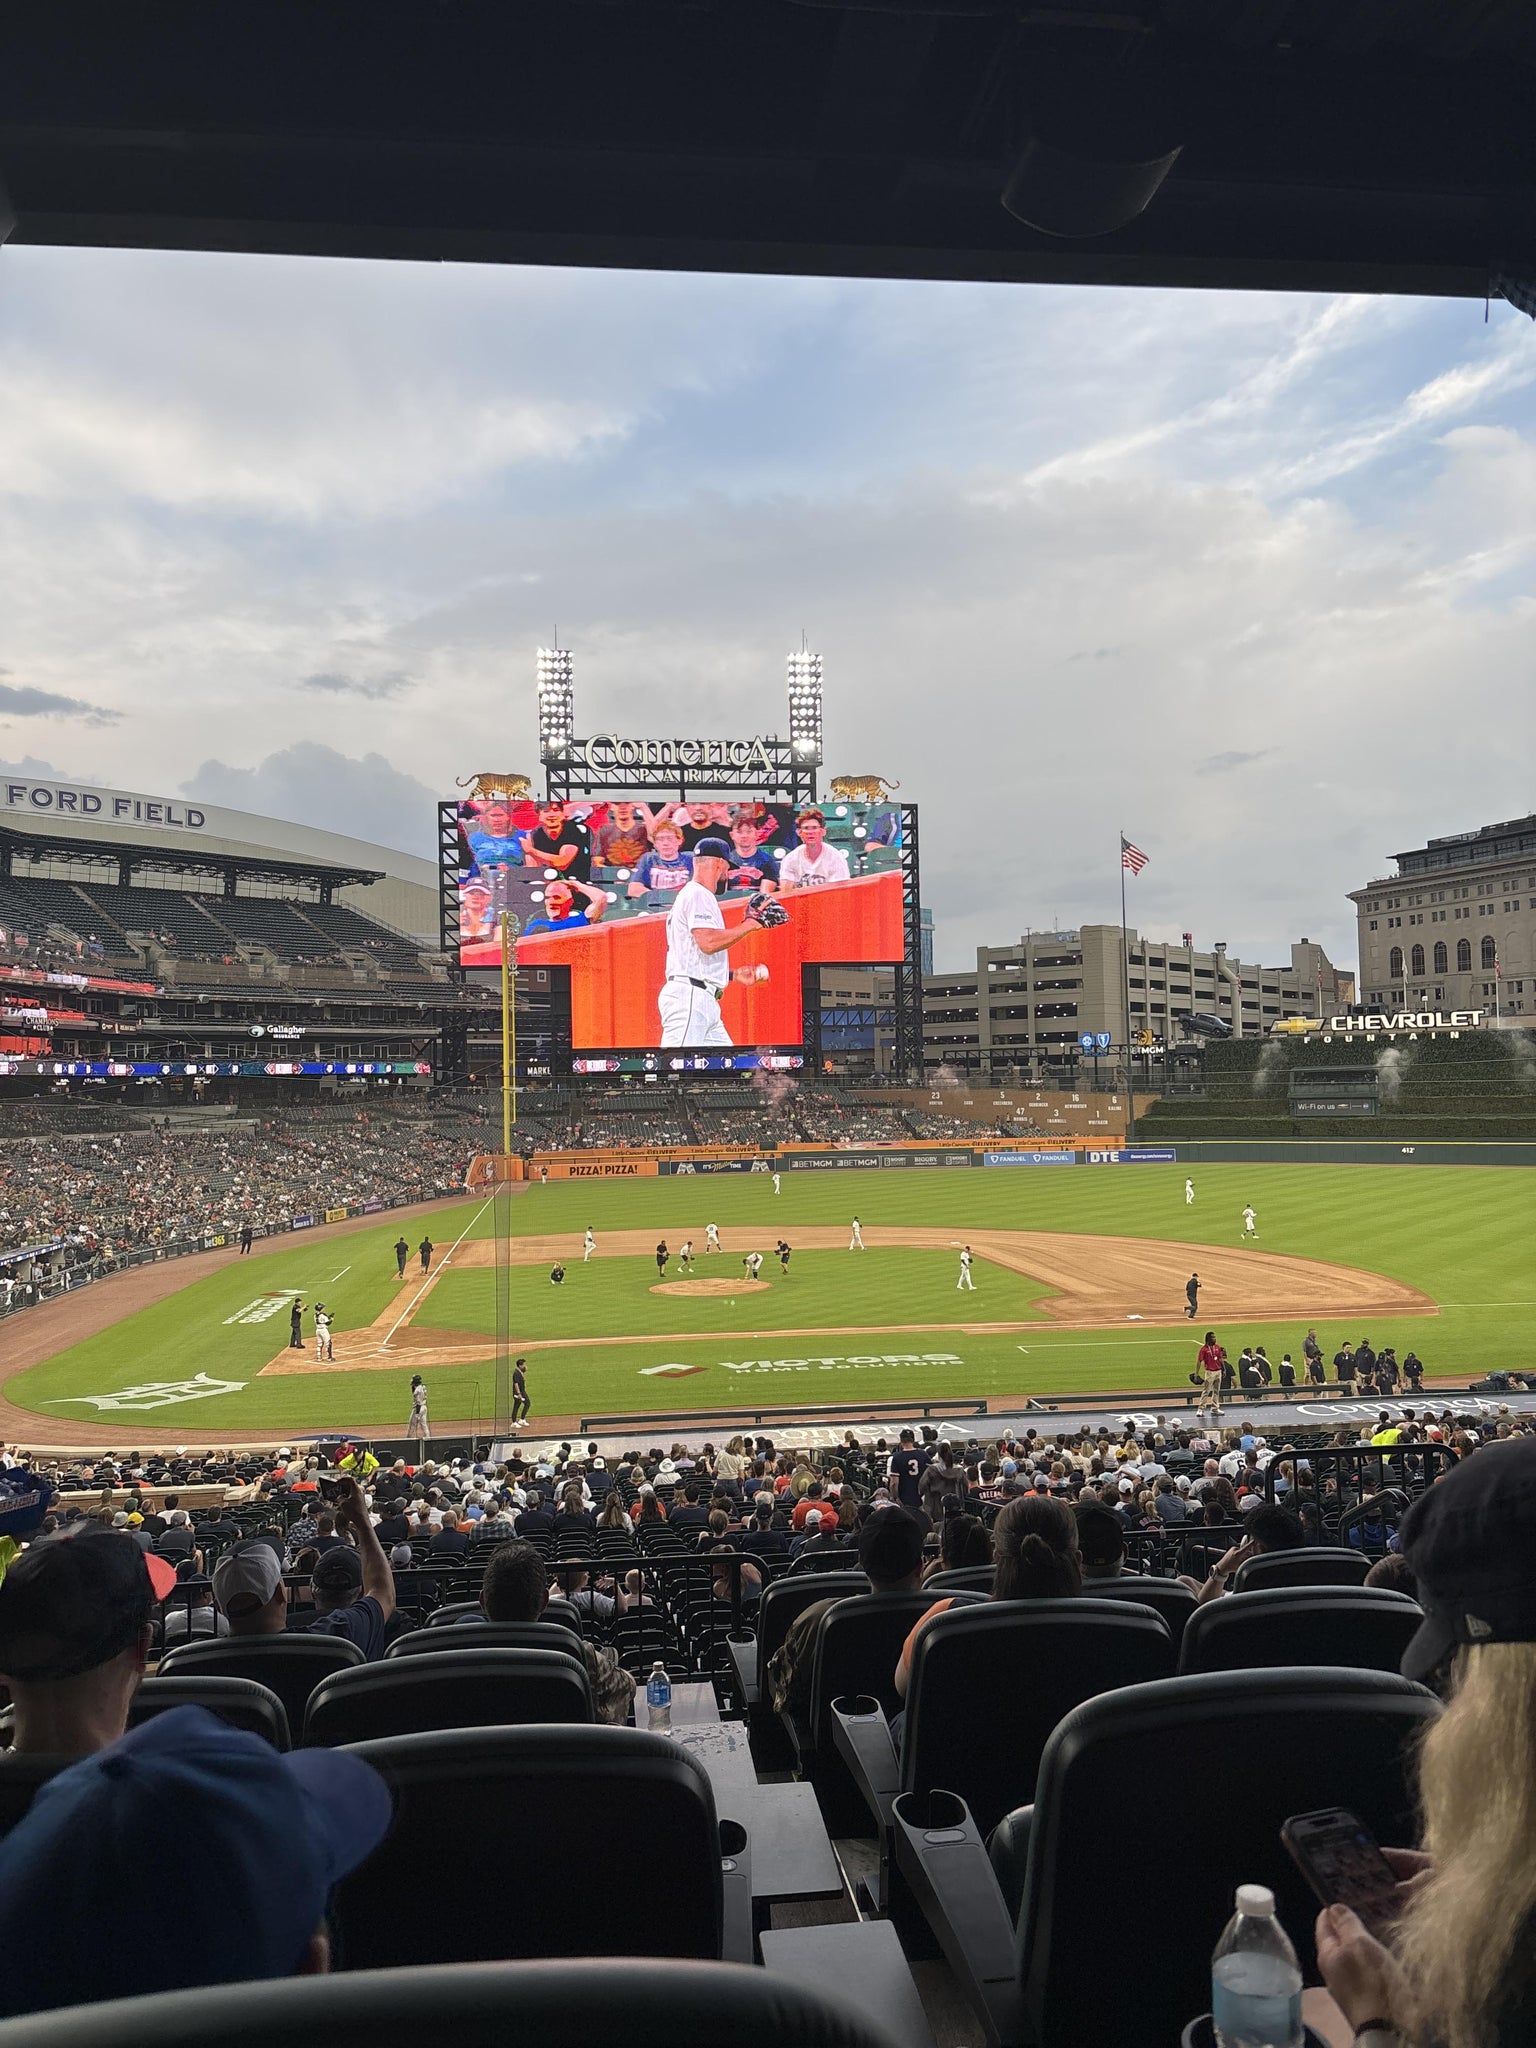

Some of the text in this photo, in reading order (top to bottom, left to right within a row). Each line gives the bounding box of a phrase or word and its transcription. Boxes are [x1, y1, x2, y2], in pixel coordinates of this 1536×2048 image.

[638, 769, 725, 782] PARK
[6, 783, 207, 829] FORD FIELD
[1331, 1010, 1485, 1031] CHEVROLET
[267, 1025, 306, 1035] Gallagher
[1303, 1031, 1460, 1044] FOUNTAIN
[931, 1091, 940, 1099] 23
[1000, 1091, 1005, 1099] 5
[1035, 1092, 1041, 1100] 2
[1072, 1094, 1080, 1102] 16
[1112, 1095, 1117, 1104] 6
[1016, 1107, 1025, 1115] 47
[1053, 1109, 1059, 1117] 3
[1095, 1110, 1100, 1118] 1
[1090, 1151, 1120, 1162] DTE
[569, 1164, 638, 1176] PIZZA! PIZZA!
[204, 1234, 225, 1248] bet365
[718, 1354, 961, 1369] VICTORS
[908, 1459, 919, 1475] 3
